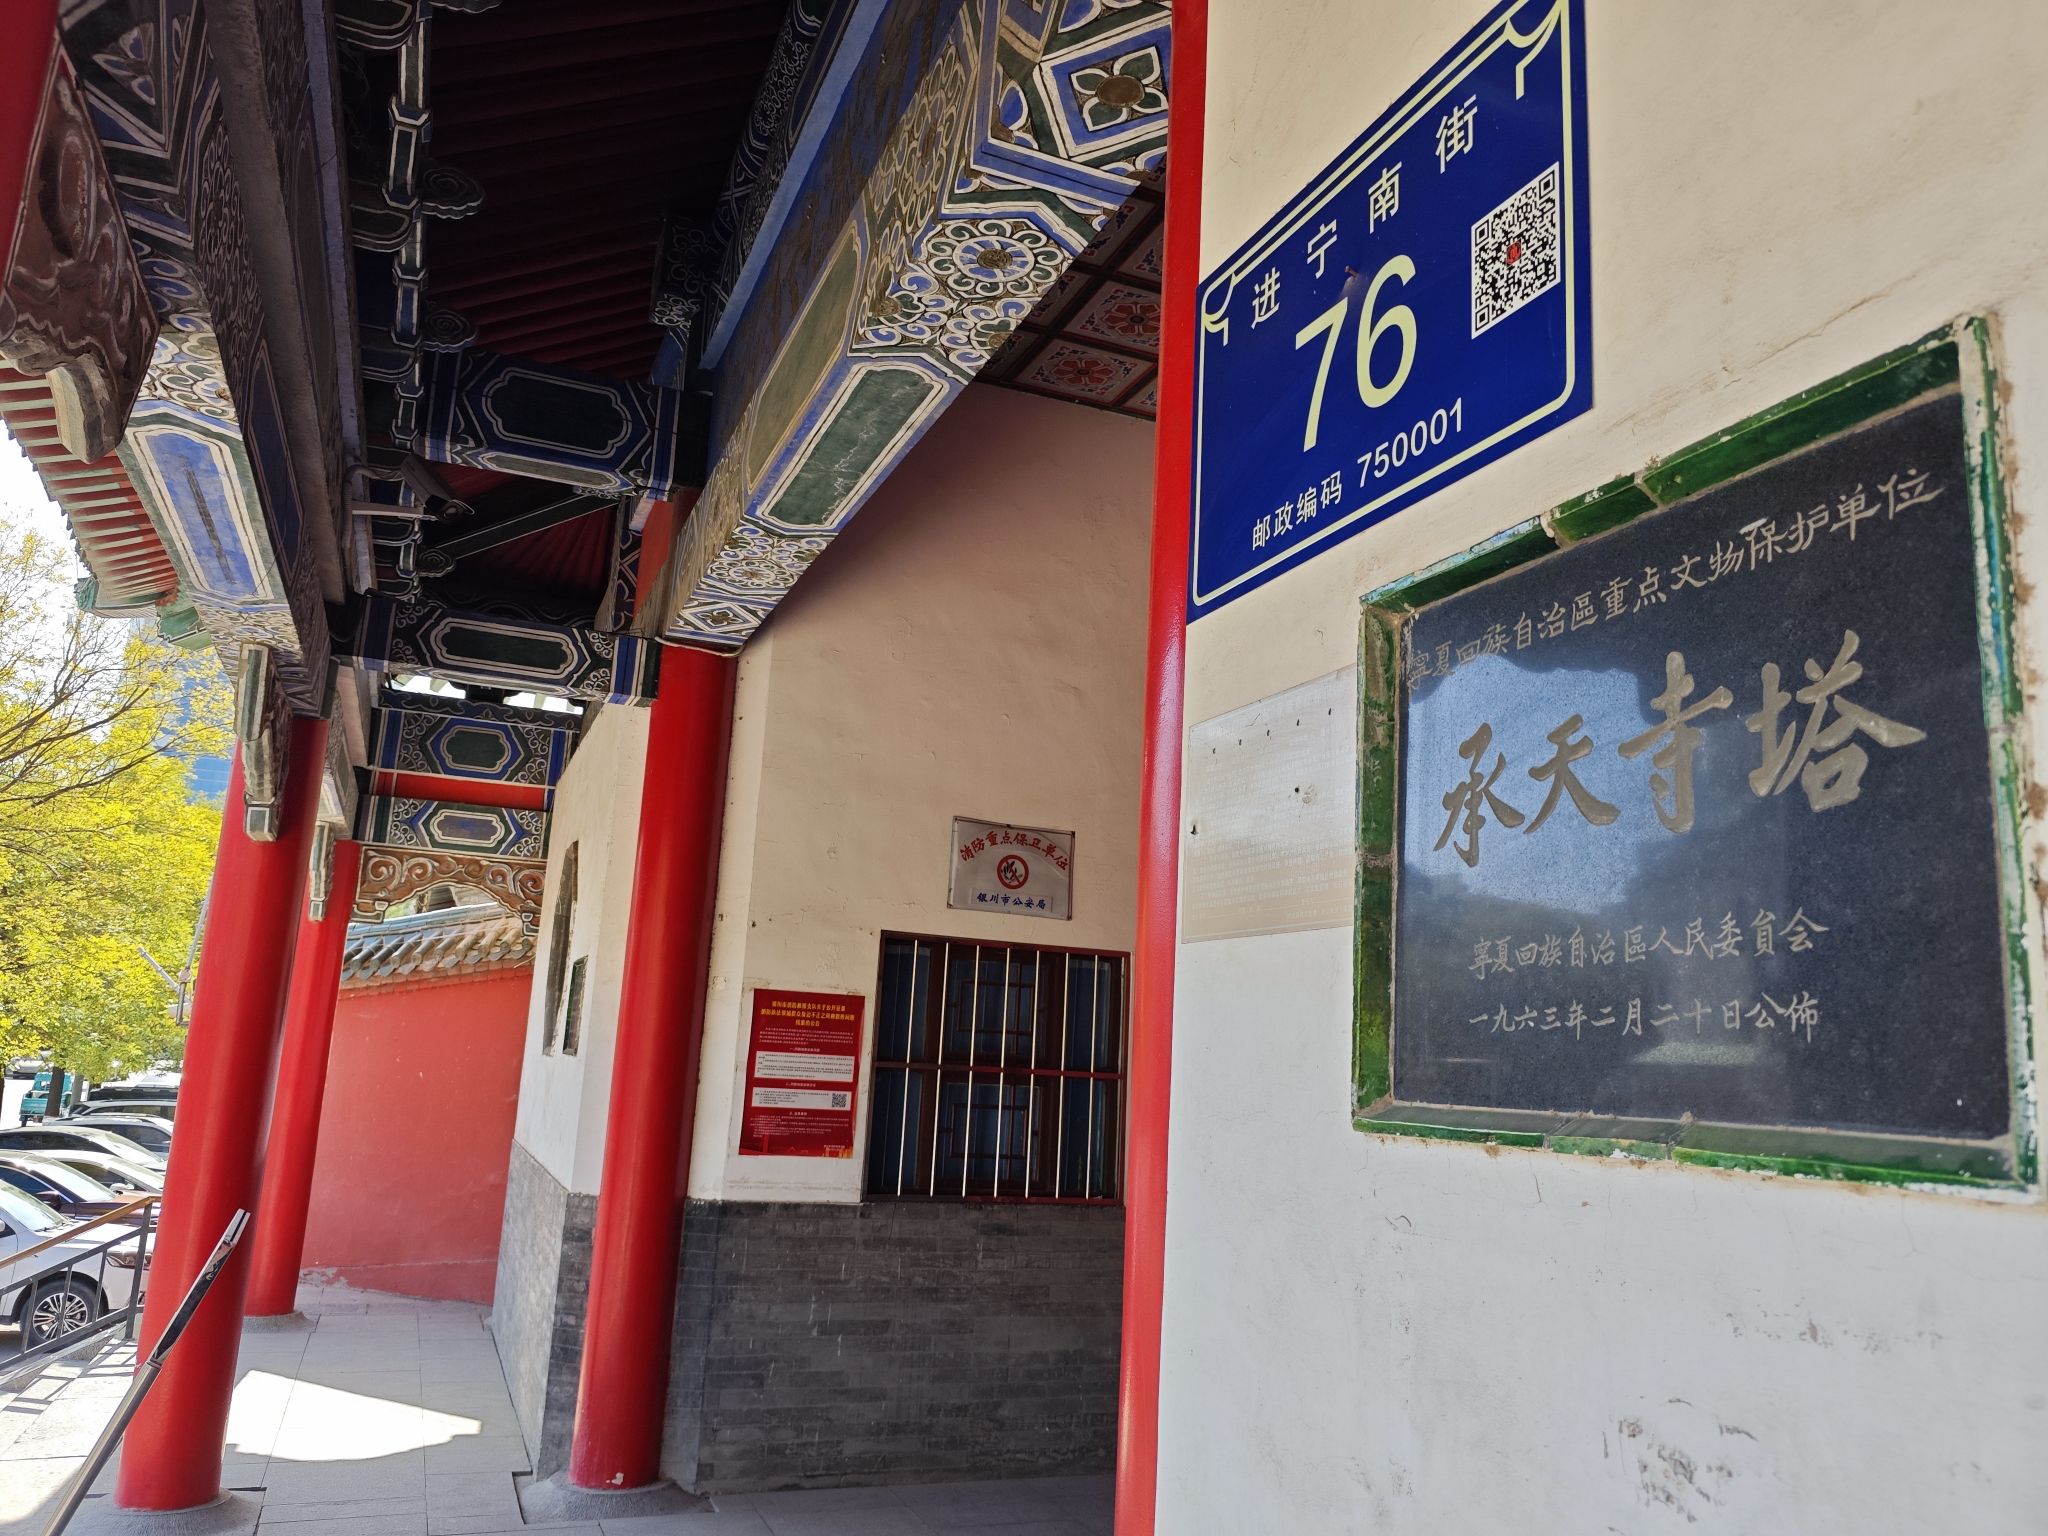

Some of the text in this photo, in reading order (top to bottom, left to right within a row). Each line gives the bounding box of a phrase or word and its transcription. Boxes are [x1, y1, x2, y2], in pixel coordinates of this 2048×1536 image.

[1251, 94, 1477, 329] 进宁南街
[1295, 254, 1417, 453] 76
[1251, 397, 1463, 552] 邮政编码 750001
[1433, 629, 1927, 868] 承天寺塔
[960, 830, 1068, 871] 消防重点保卫单位
[977, 892, 1046, 910] 银川市公安局
[1468, 991, 1820, 1043] 一九六三年二月二十日公佈
